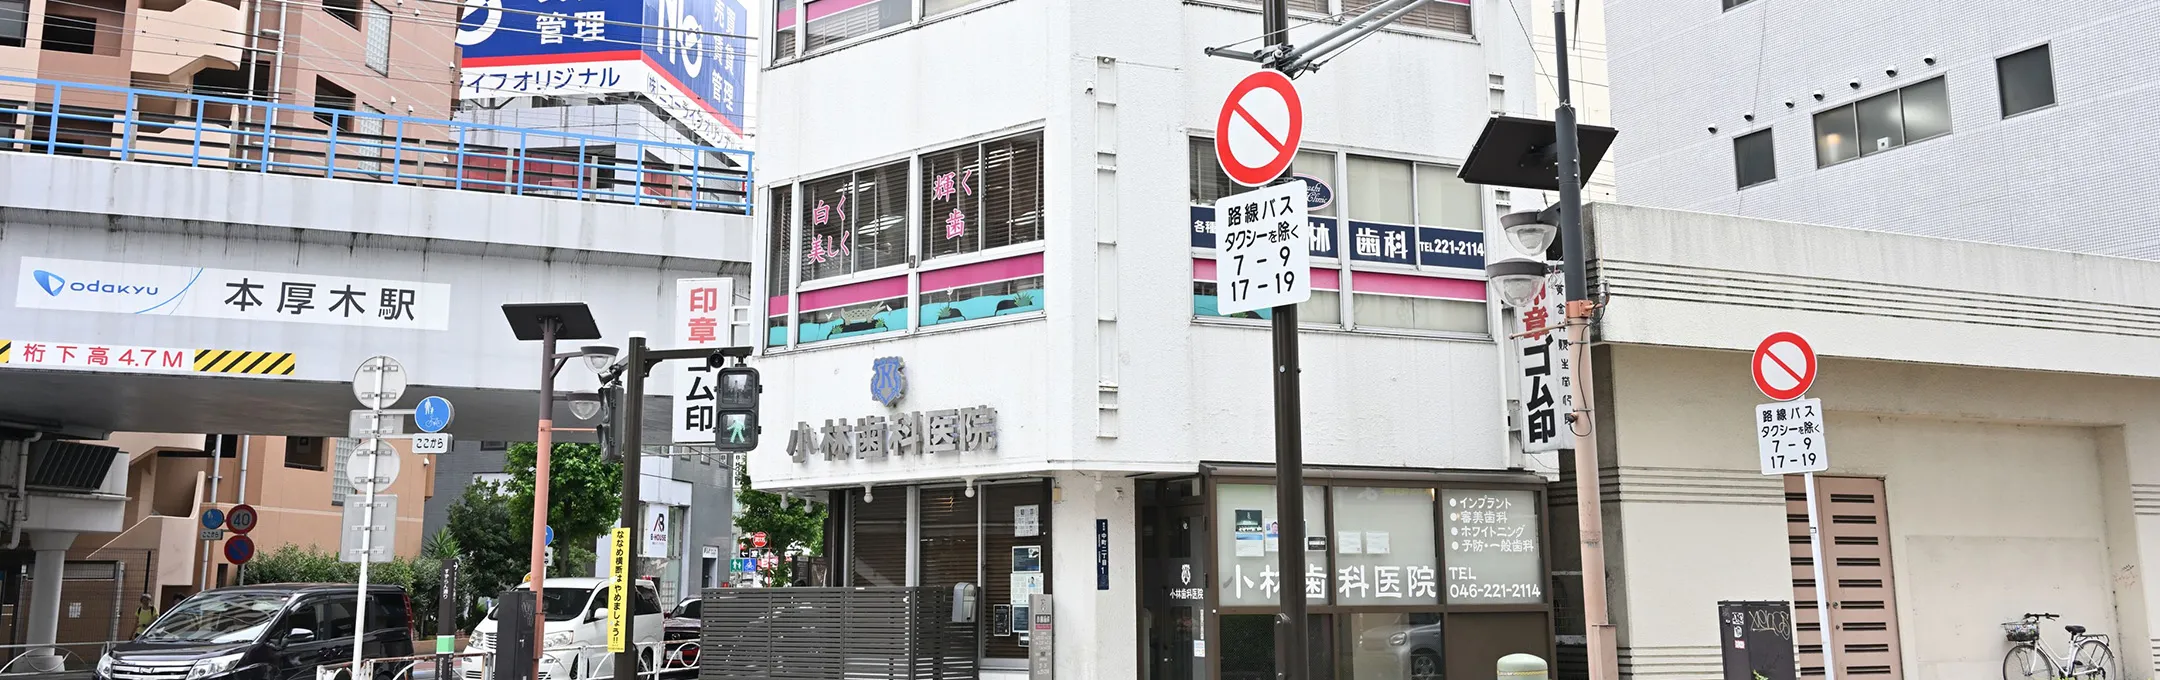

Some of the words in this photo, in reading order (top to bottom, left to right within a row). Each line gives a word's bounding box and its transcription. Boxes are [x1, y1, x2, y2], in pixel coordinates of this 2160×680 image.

[536, 11, 605, 45] 管理
[460, 67, 621, 93] イフオリジナル
[934, 169, 973, 203] 輝く
[813, 195, 846, 226] 白く
[1228, 196, 1293, 227] 路線バス
[945, 208, 965, 240] 歯
[1225, 221, 1299, 252] タクシーを除く
[808, 231, 850, 265] 美しく
[1356, 228, 1408, 259] 歯科
[70, 280, 158, 296] odakyu
[224, 277, 416, 321] 本厚木駅
[688, 287, 717, 343] 印章
[1523, 334, 1556, 443] ゴム印
[1762, 405, 1815, 423] 路線バス
[786, 405, 999, 463] 小林歯科医院
[1761, 421, 1820, 438] タクシーを除く
[416, 438, 443, 449] ここから
[1460, 494, 1511, 509] インプラント
[233, 513, 250, 525] 40
[1461, 511, 1507, 523] 審美歯科
[1461, 525, 1525, 538] ホワイトニング
[1462, 540, 1534, 552] 予防・一般歯科
[1449, 567, 1476, 580] TEL
[1170, 588, 1204, 600] 小林歯科医院
[1450, 584, 1540, 598] 046-221-2114
